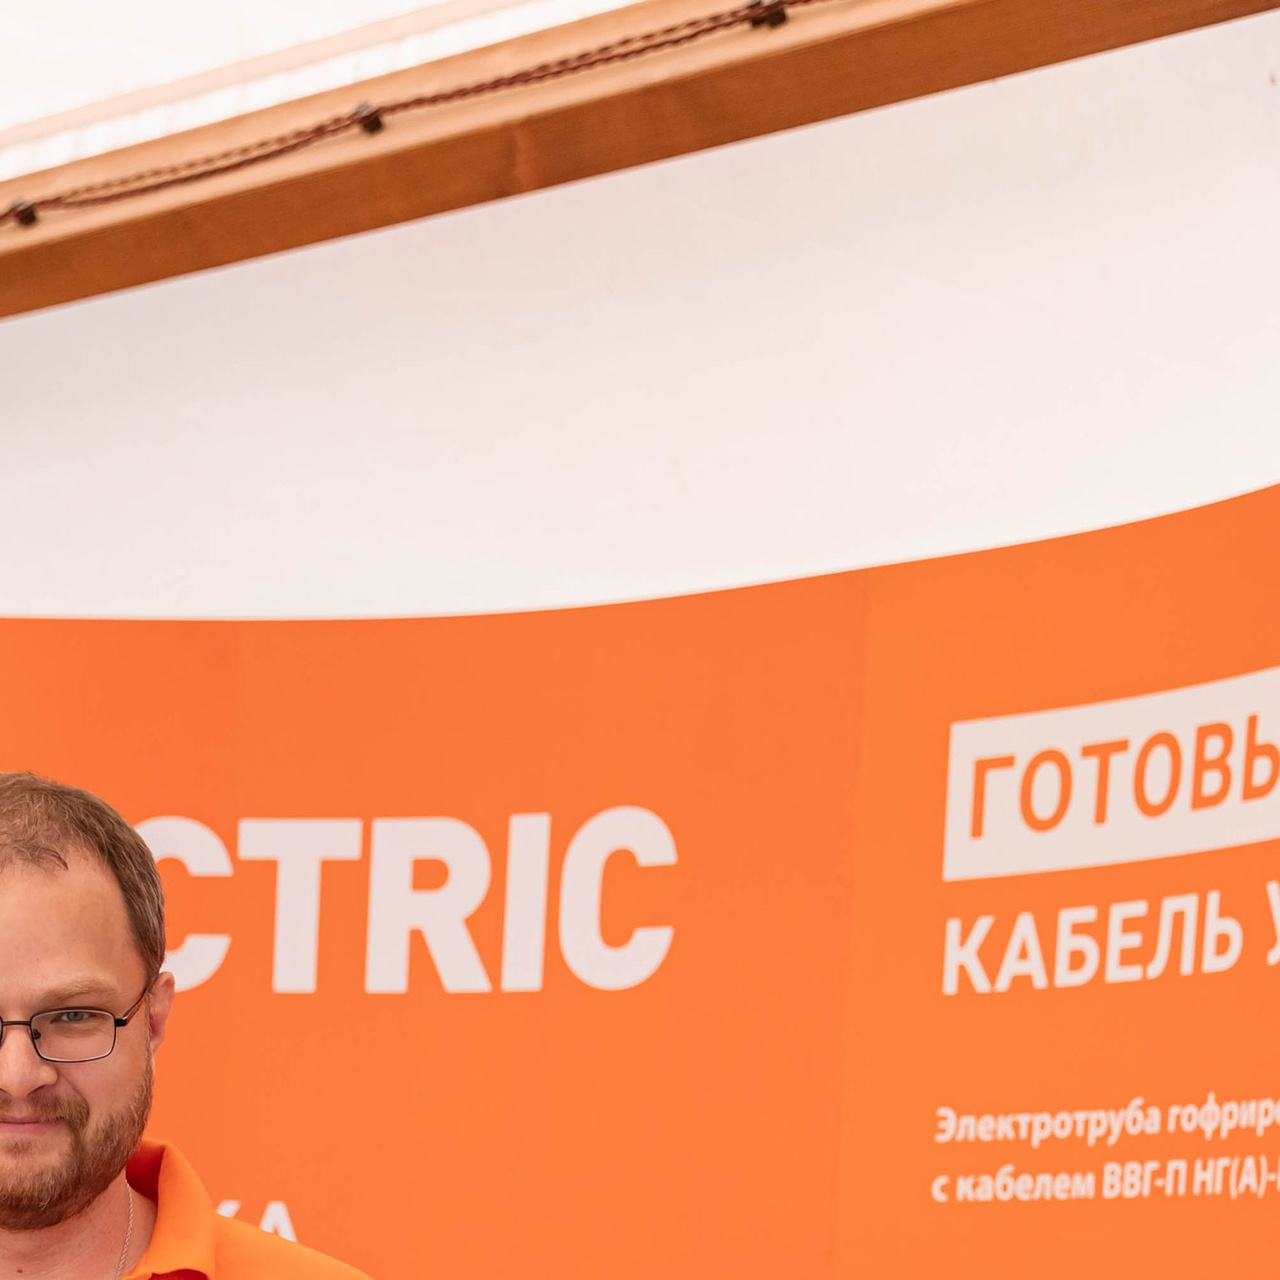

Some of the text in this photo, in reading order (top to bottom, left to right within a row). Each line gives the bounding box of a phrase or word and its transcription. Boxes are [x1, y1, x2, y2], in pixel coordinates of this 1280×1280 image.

[942, 890, 1245, 997] КАБЕЛЬ
[934, 1092, 1280, 1149] Электротруба гофрир
[931, 1154, 1280, 1202] с кабелем ВВГ-П НГ(А)-
